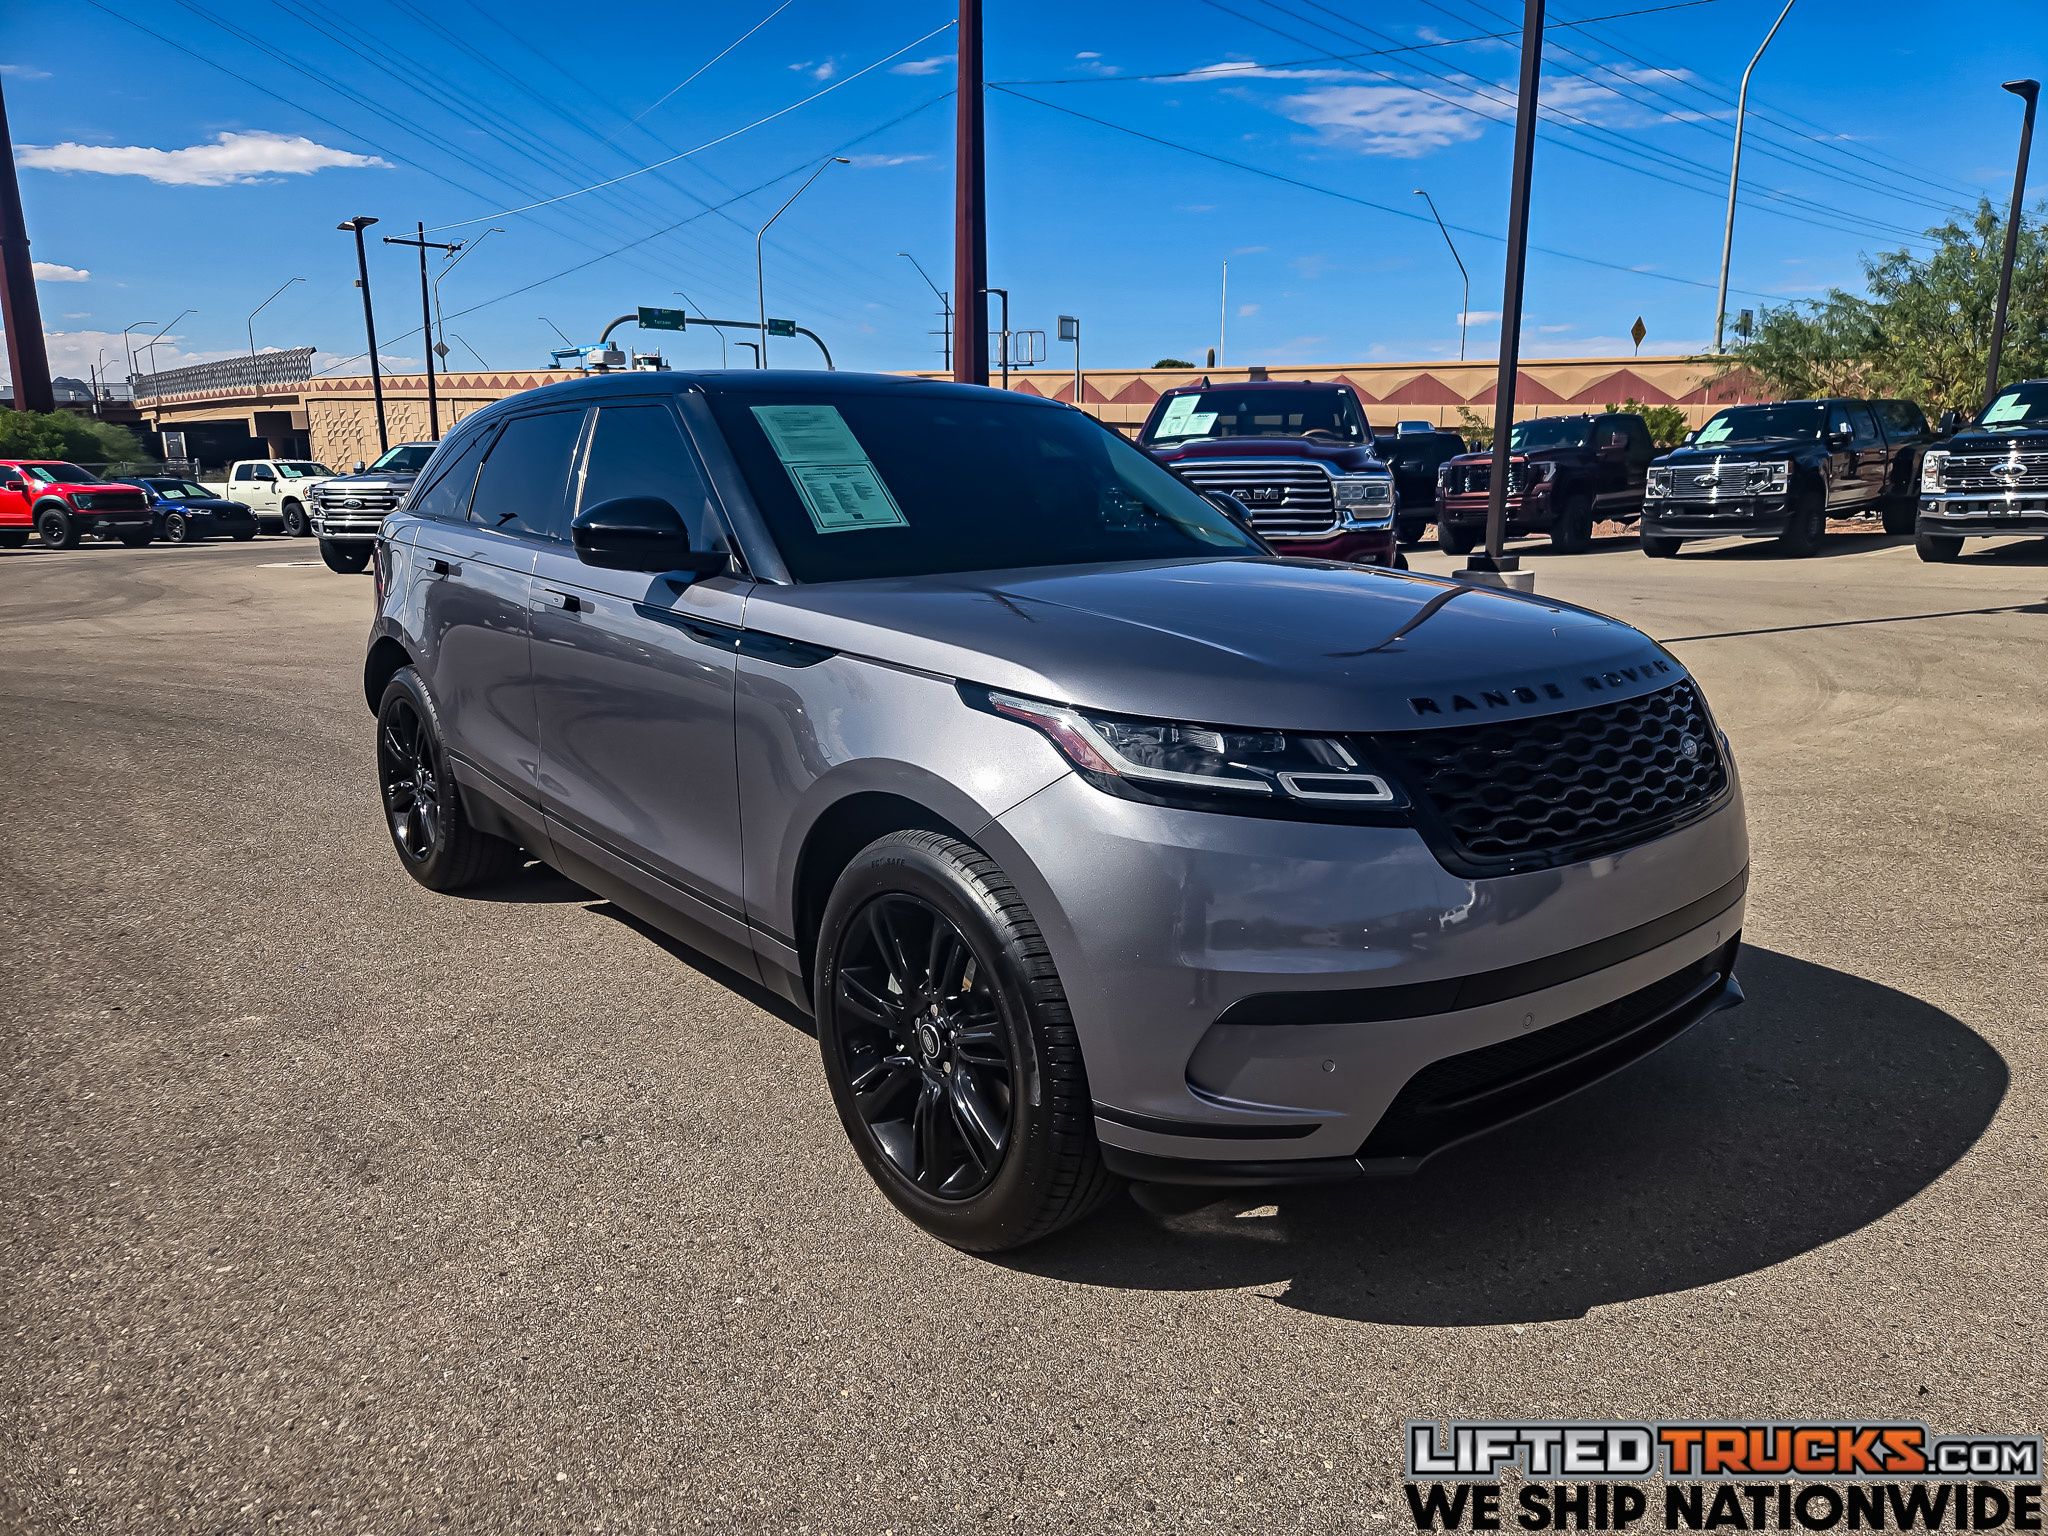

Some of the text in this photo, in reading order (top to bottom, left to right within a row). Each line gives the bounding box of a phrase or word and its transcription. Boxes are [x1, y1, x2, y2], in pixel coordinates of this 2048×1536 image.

[1229, 488, 1279, 500] AM
[1407, 660, 1671, 716] RANGE ROVER
